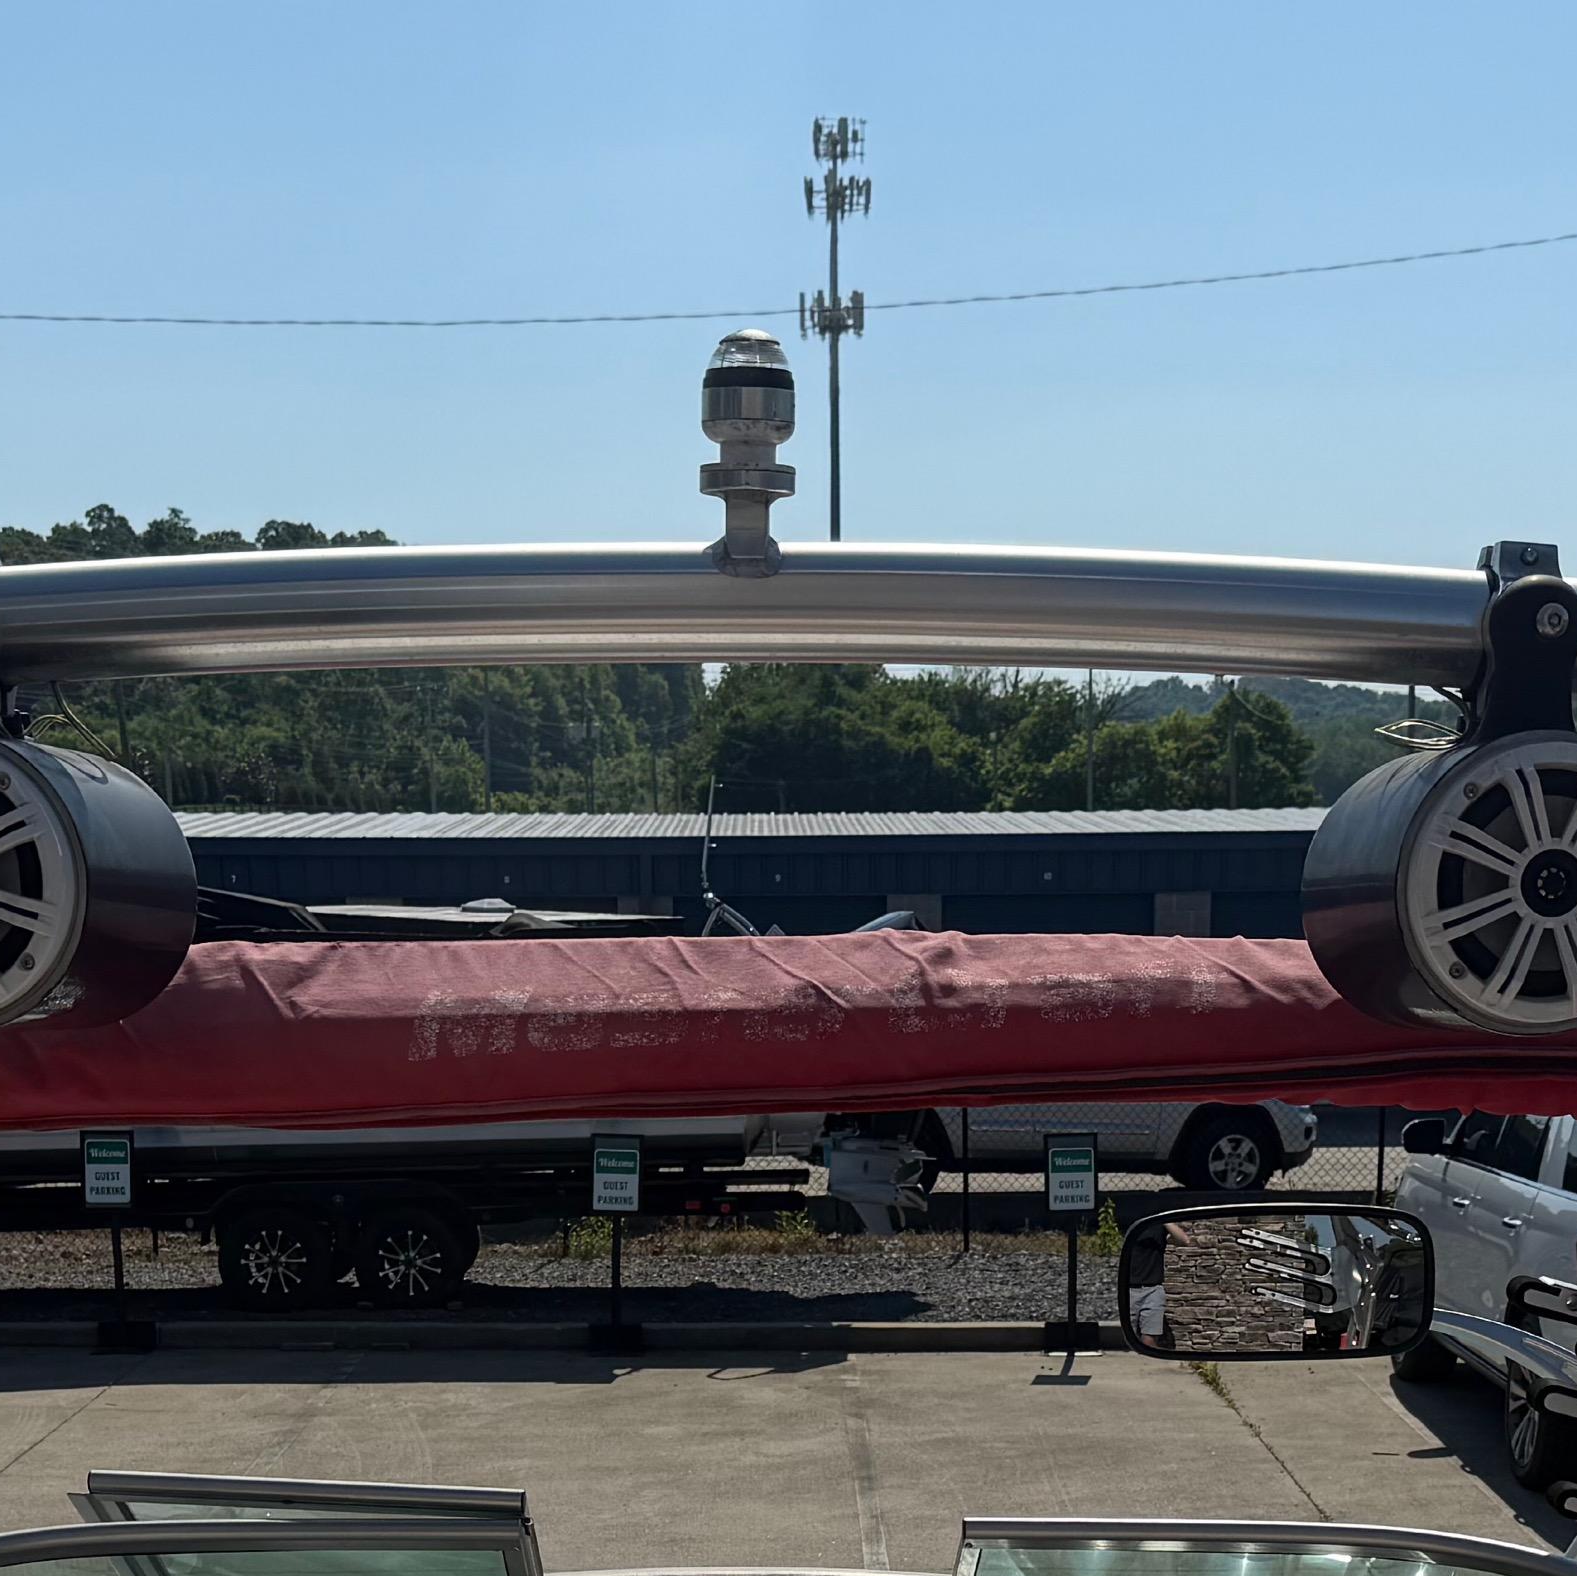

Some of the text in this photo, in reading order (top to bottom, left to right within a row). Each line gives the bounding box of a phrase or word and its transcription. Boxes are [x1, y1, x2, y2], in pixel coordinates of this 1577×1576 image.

[89, 1147, 126, 1157] Welcome
[598, 1158, 635, 1167] Welcome
[1053, 1156, 1090, 1166] Welcome
[95, 1172, 120, 1181] GUEST
[603, 1181, 628, 1190] GUEST
[1058, 1180, 1084, 1189] GUEST
[90, 1186, 126, 1195] PARKING
[597, 1195, 634, 1205] PARKING
[1053, 1195, 1090, 1204] PARKING
